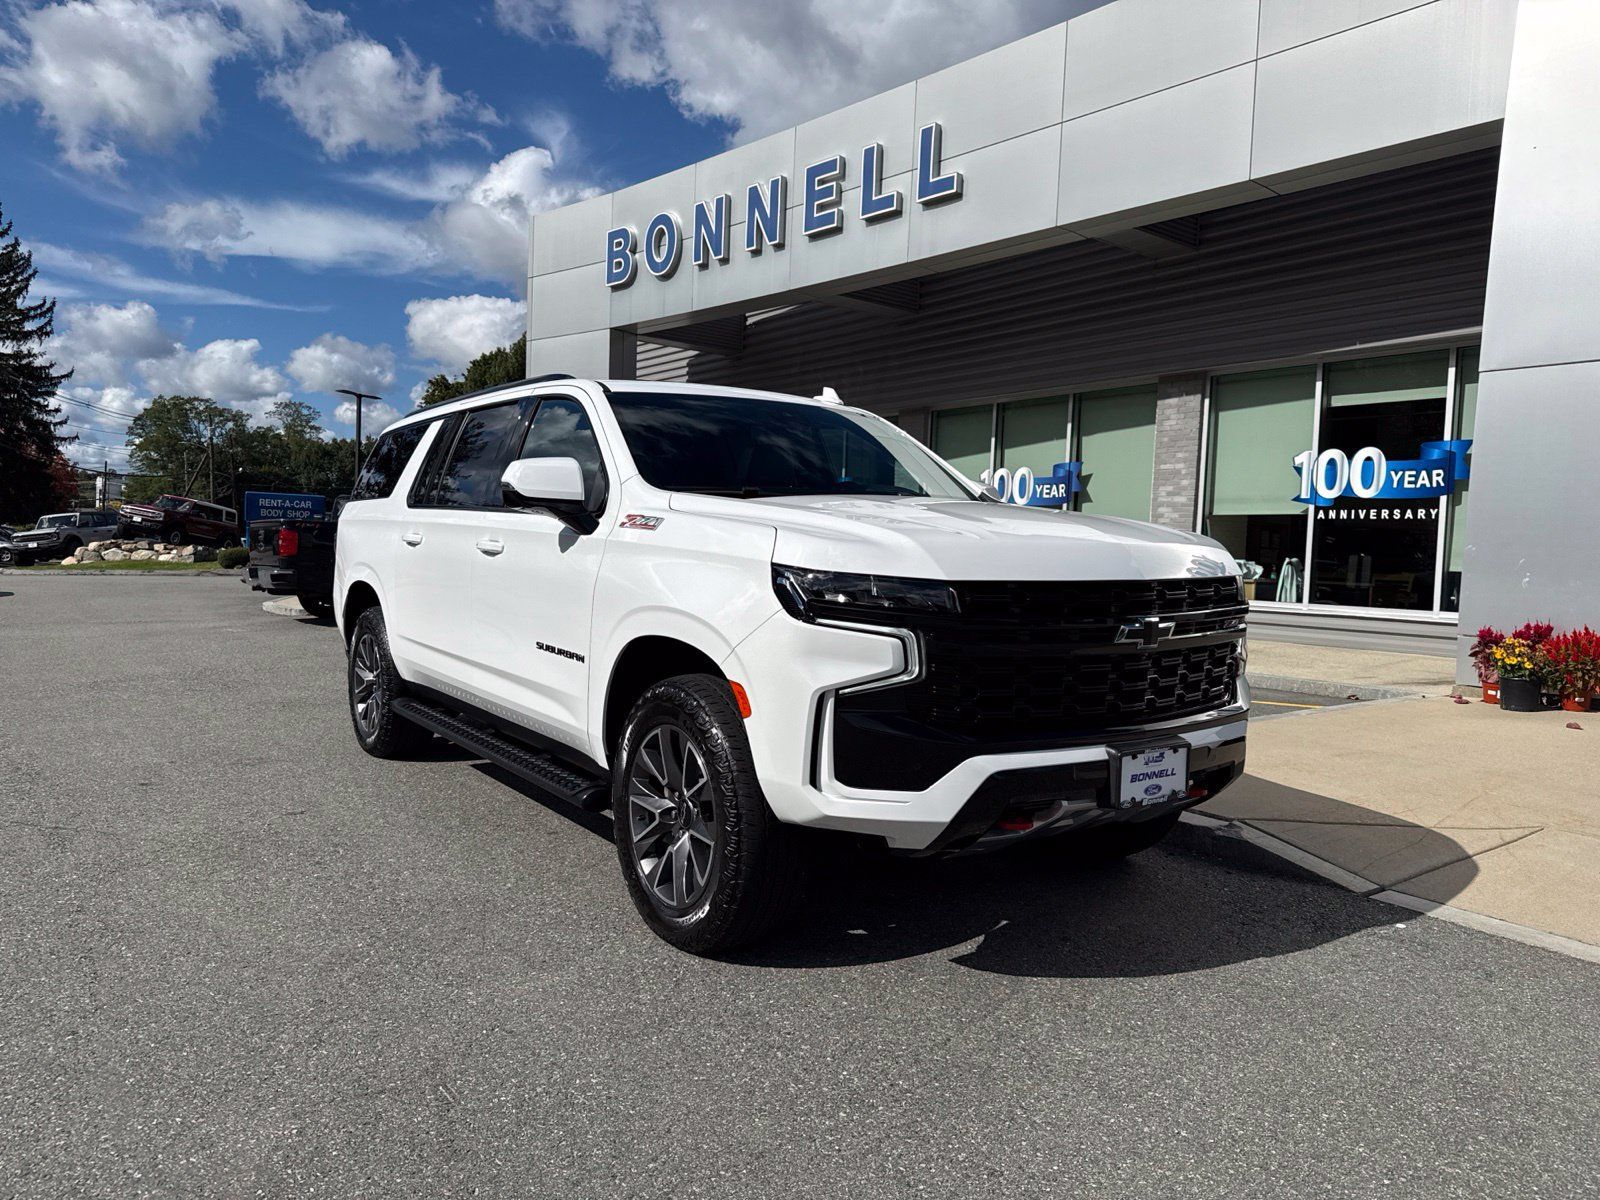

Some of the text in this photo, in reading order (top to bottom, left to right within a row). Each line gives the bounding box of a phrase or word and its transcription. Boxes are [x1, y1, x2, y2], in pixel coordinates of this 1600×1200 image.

[605, 122, 963, 288] BONNELL
[1293, 446, 1445, 498] 100 YEAR
[1035, 484, 1066, 498] YEAR
[259, 498, 312, 508] RENT-A-CAR
[260, 509, 311, 518] BODY SHOP
[1317, 509, 1439, 520] ANNIVERSARY
[536, 641, 585, 664] SUBURBAN
[1130, 768, 1177, 783] BONNELL
